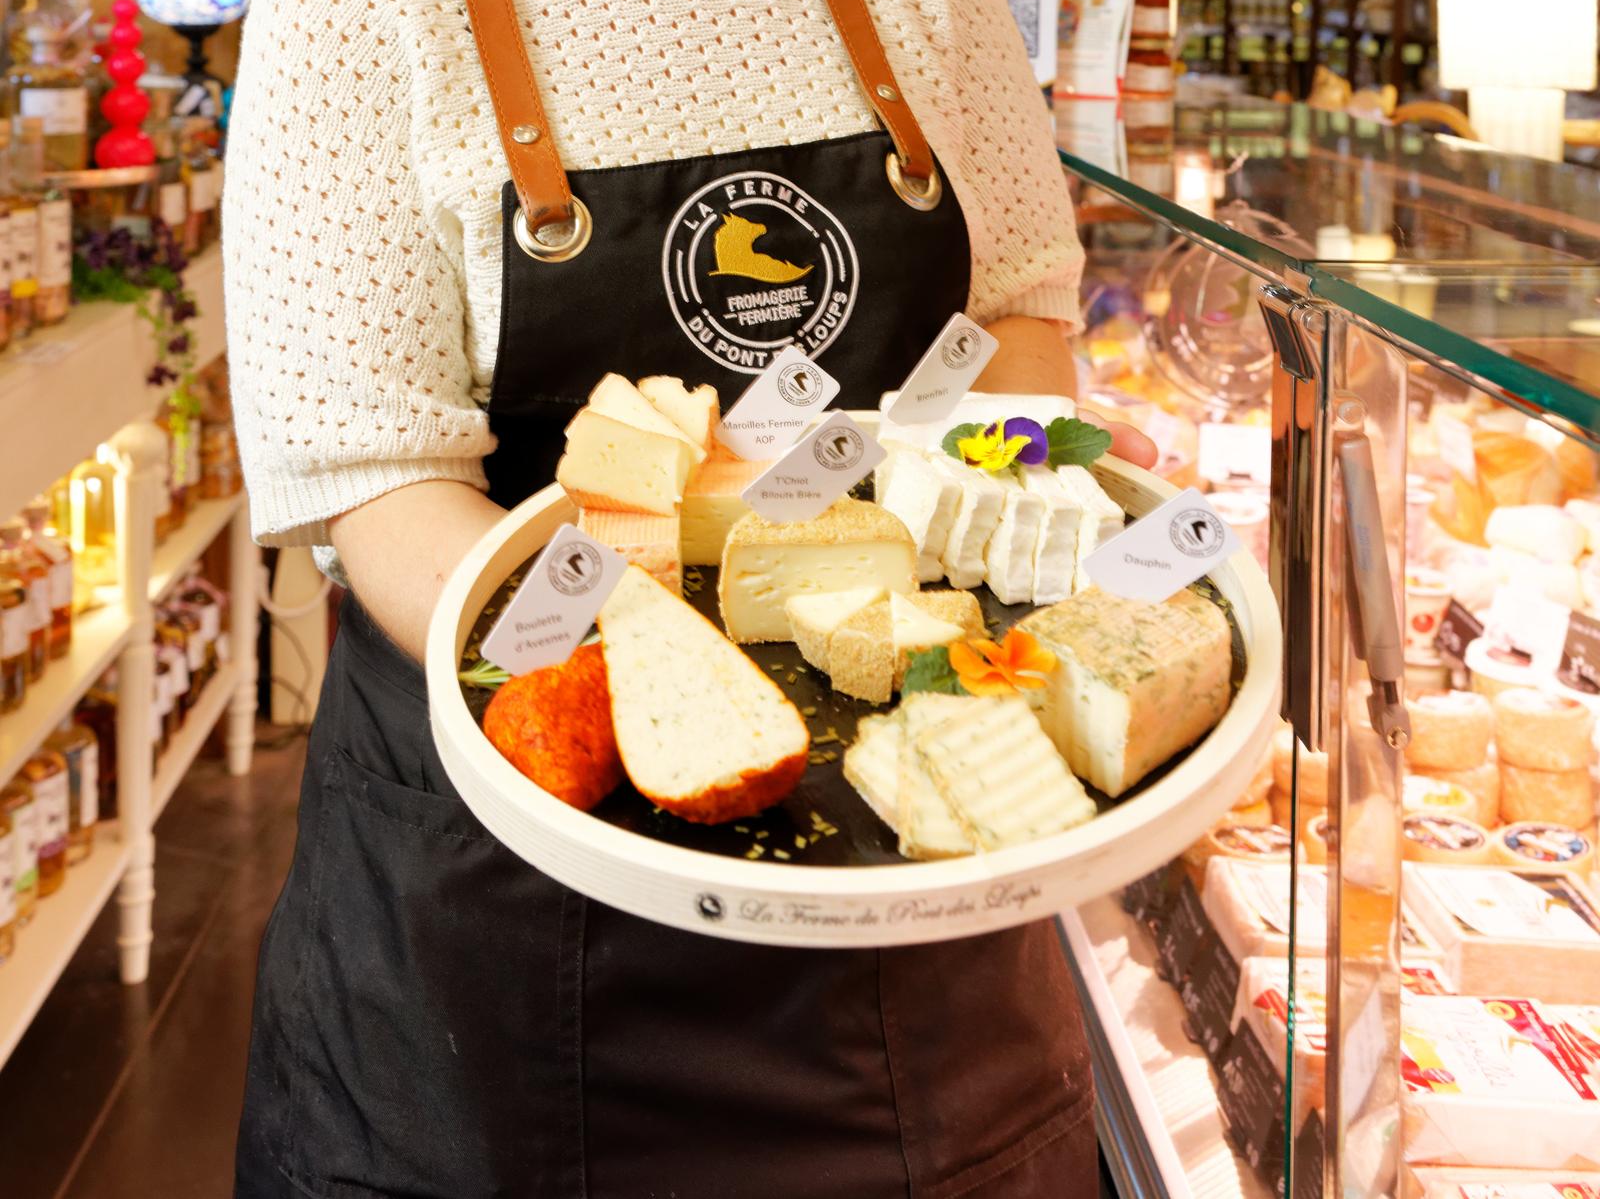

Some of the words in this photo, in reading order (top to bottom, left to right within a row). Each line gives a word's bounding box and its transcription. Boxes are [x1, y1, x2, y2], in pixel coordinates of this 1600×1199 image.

[684, 200, 715, 230] LA
[724, 180, 809, 214] FERME
[727, 285, 809, 312] FROMAGERIE
[738, 303, 802, 326] FERMIÈRE
[687, 315, 714, 342] DU
[715, 340, 768, 367] PONT
[808, 290, 848, 349] LOUPS
[722, 420, 766, 431] Maroilles
[768, 418, 805, 429] Fermier
[755, 434, 775, 445] AOP
[797, 489, 822, 500] Bière
[1123, 553, 1173, 570] Dauphin
[515, 612, 563, 633] Boulette
[738, 899, 773, 923] La
[780, 904, 850, 925] Ferme
[854, 906, 879, 924] du
[887, 899, 944, 924] Pont
